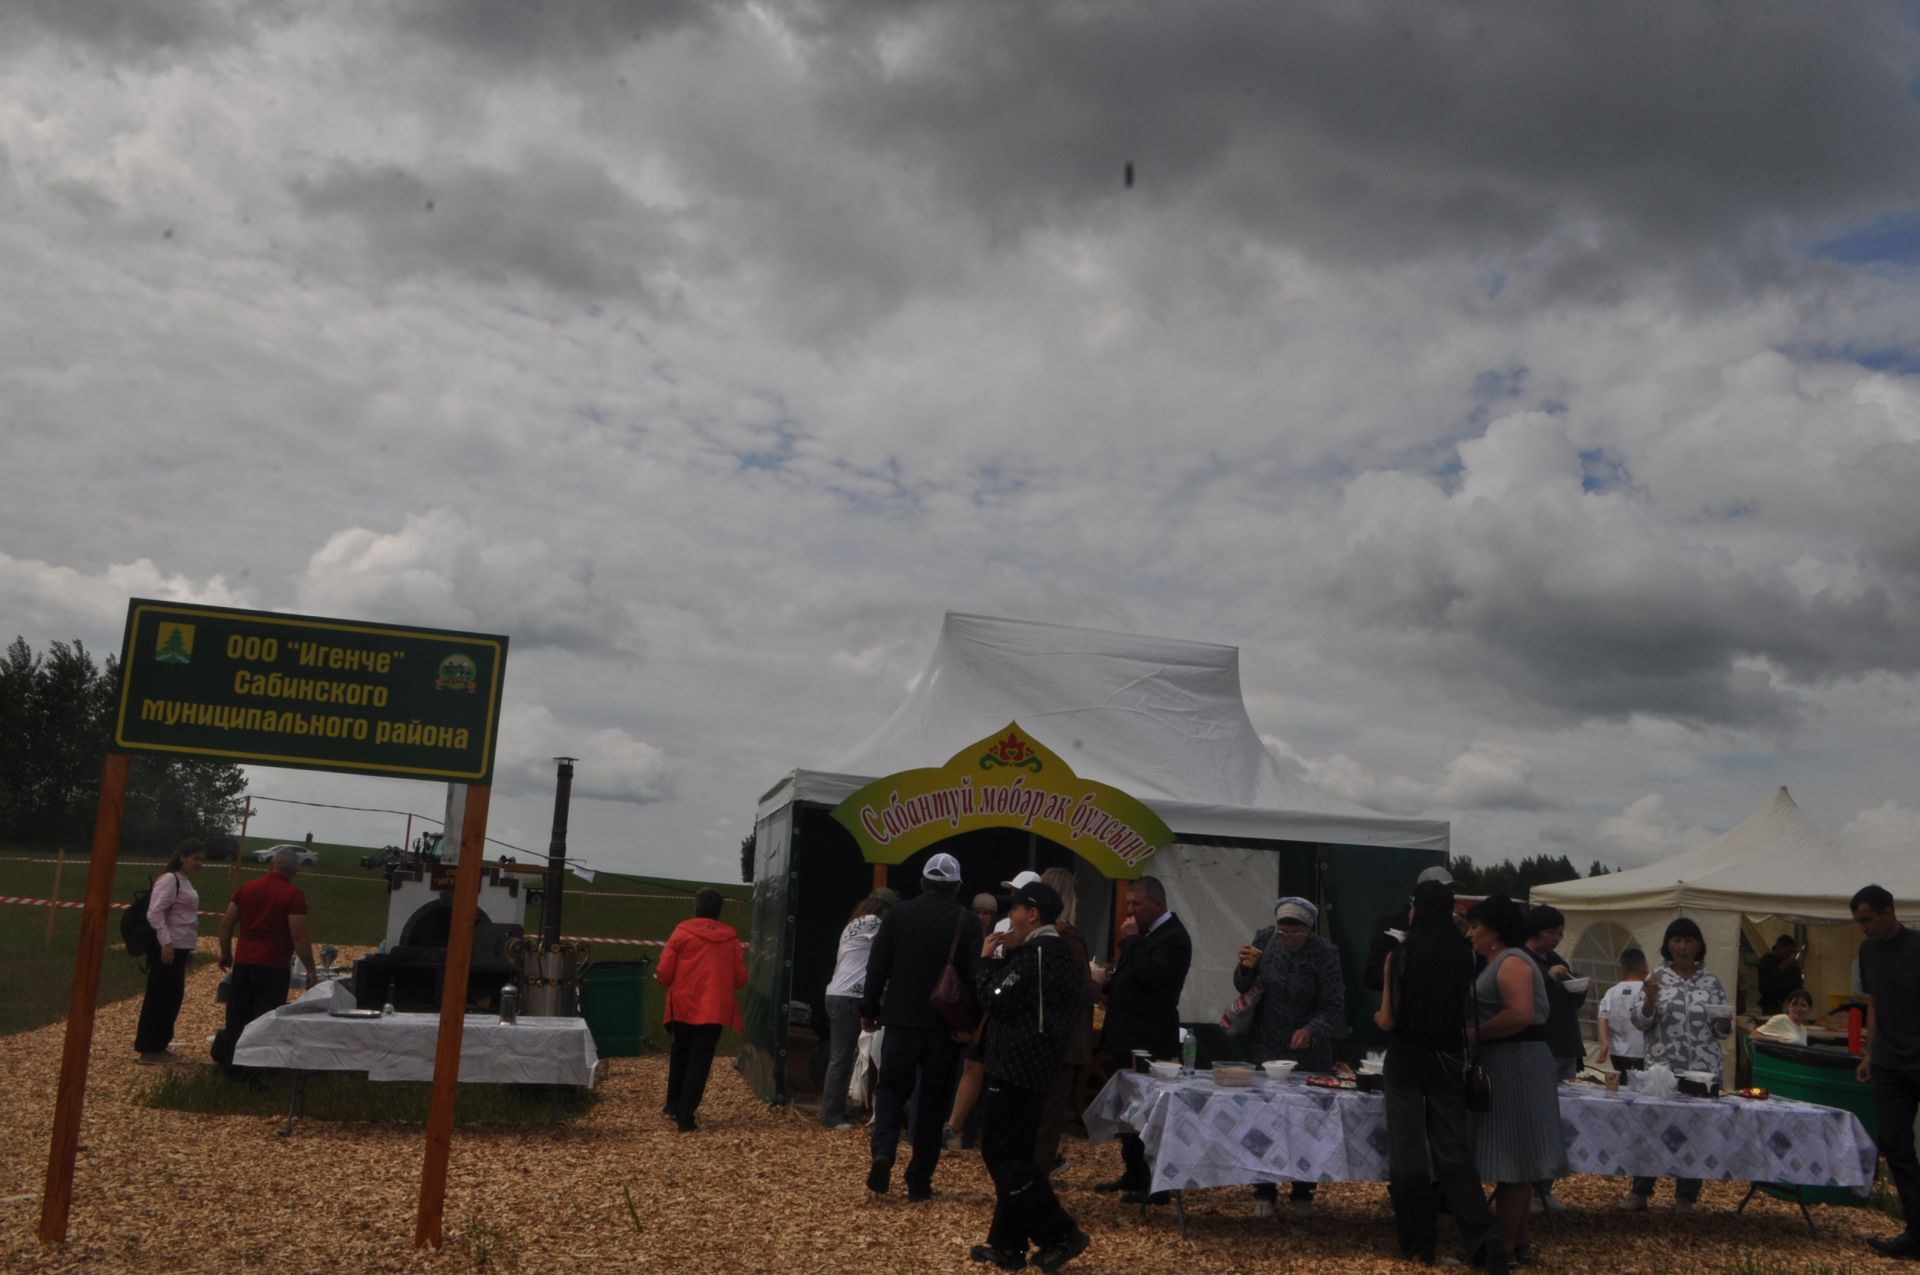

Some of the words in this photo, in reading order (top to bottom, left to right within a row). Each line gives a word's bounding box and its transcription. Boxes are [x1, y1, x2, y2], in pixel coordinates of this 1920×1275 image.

[226, 635, 278, 662] ООО
[233, 670, 388, 707] Сабинского
[140, 698, 368, 740] муниципального
[375, 718, 469, 750] района
[860, 776, 975, 844] Сабантуй
[979, 775, 1073, 828] мөбәрәк
[1069, 793, 1156, 868] булсын!
